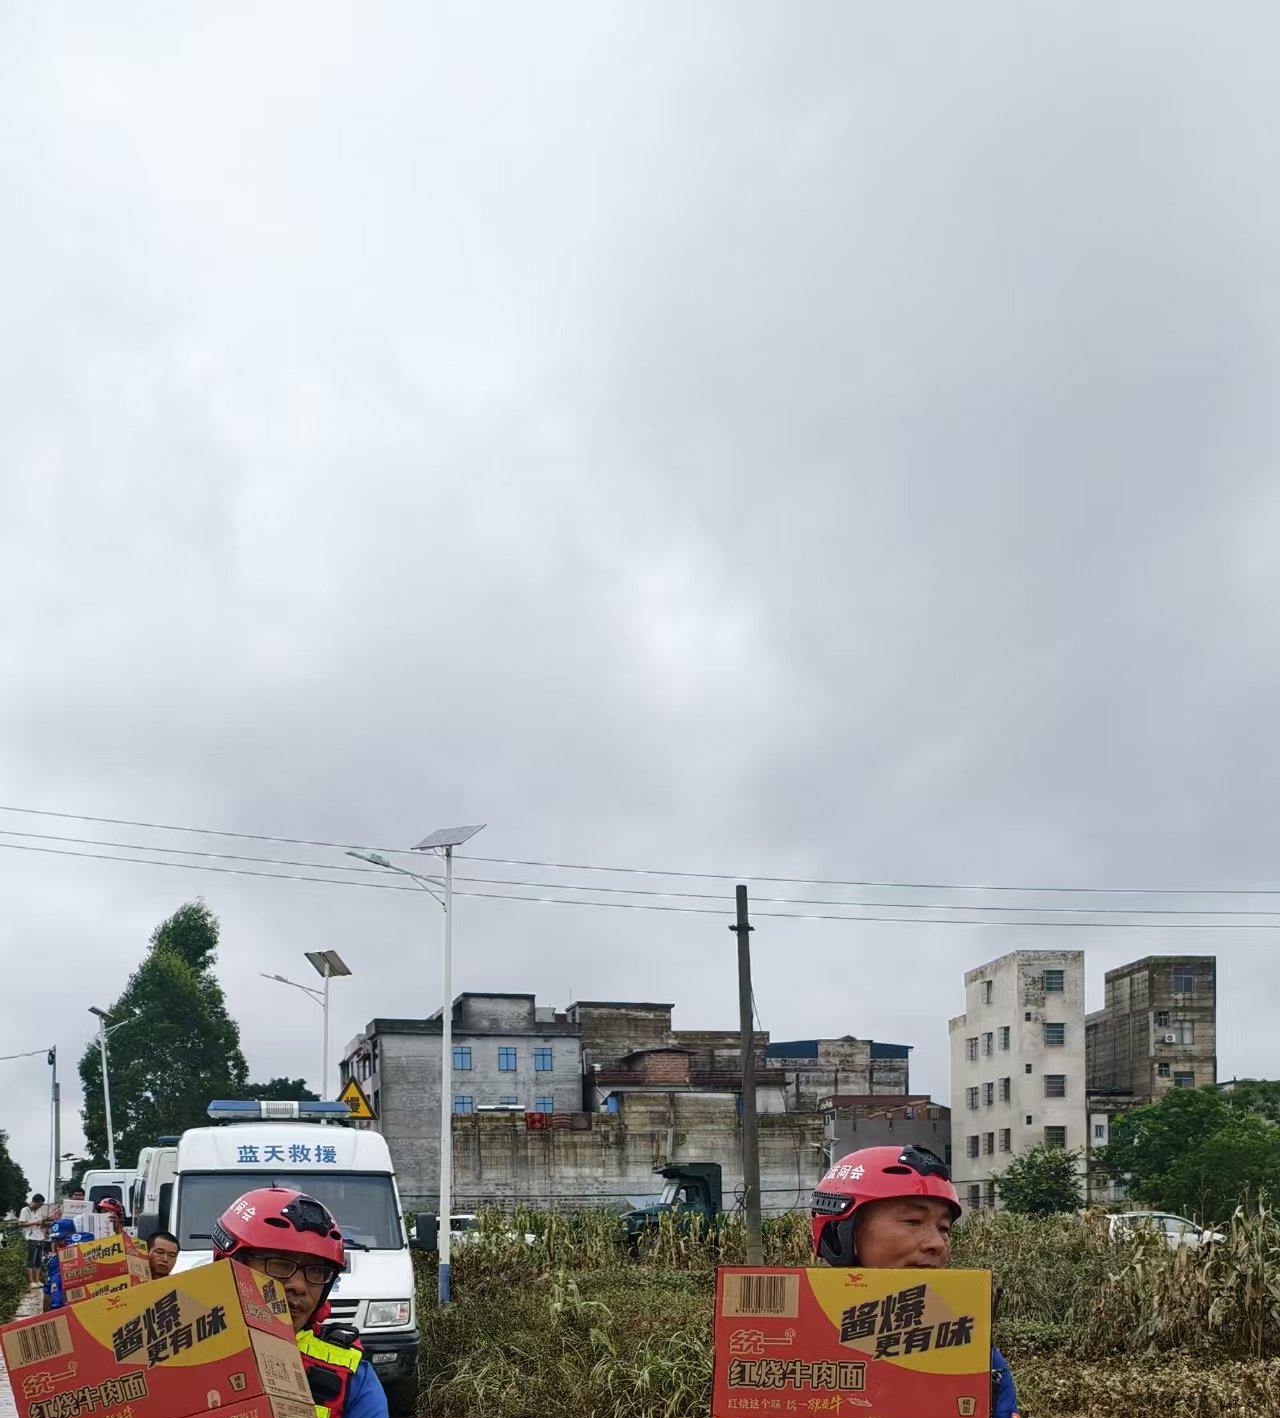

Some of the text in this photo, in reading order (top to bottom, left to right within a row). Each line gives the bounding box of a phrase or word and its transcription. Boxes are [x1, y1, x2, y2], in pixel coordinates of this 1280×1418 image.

[237, 1144, 336, 1164] 蓝天救援
[112, 1289, 181, 1362] 酱爆
[840, 1284, 927, 1345] 酱爆
[147, 1305, 227, 1368] 更有味
[729, 1329, 793, 1355] 统一
[873, 1315, 974, 1360] 更有味
[22, 1370, 76, 1399] 统一
[727, 1359, 866, 1391] 红烧牛肉面
